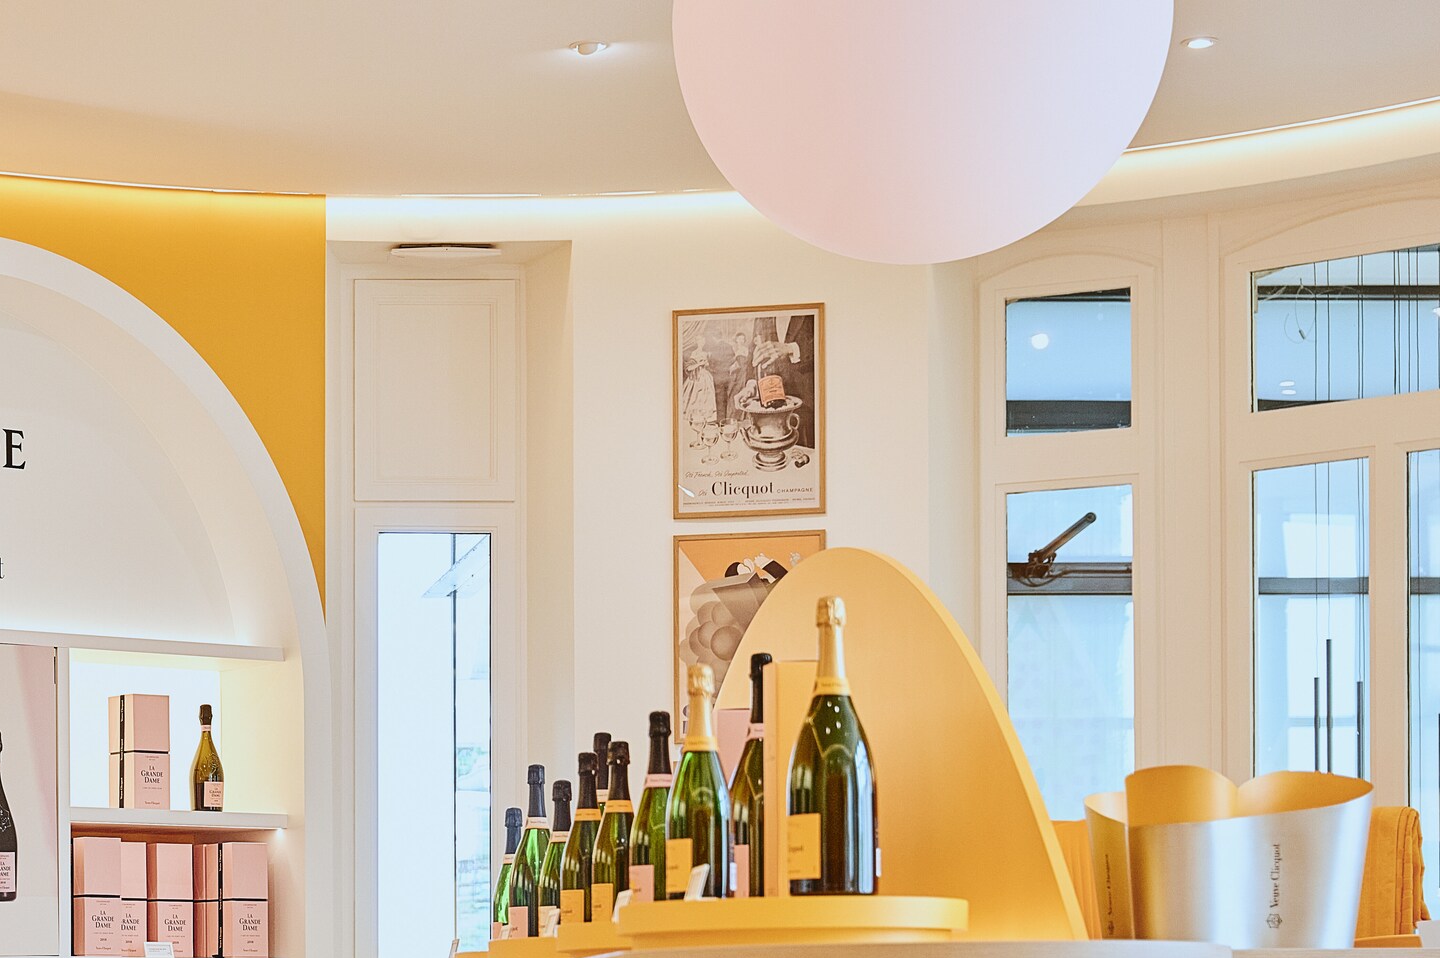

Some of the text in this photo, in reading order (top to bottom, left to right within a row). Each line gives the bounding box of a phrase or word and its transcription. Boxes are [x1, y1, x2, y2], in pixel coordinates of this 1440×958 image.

[711, 481, 773, 499] Clicquot
[140, 769, 164, 777] GRANDE
[144, 776, 160, 784] DAME
[1269, 844, 1282, 908] Veuve Clicquot
[91, 914, 114, 922] GRANDE
[239, 917, 261, 925] GRANDE
